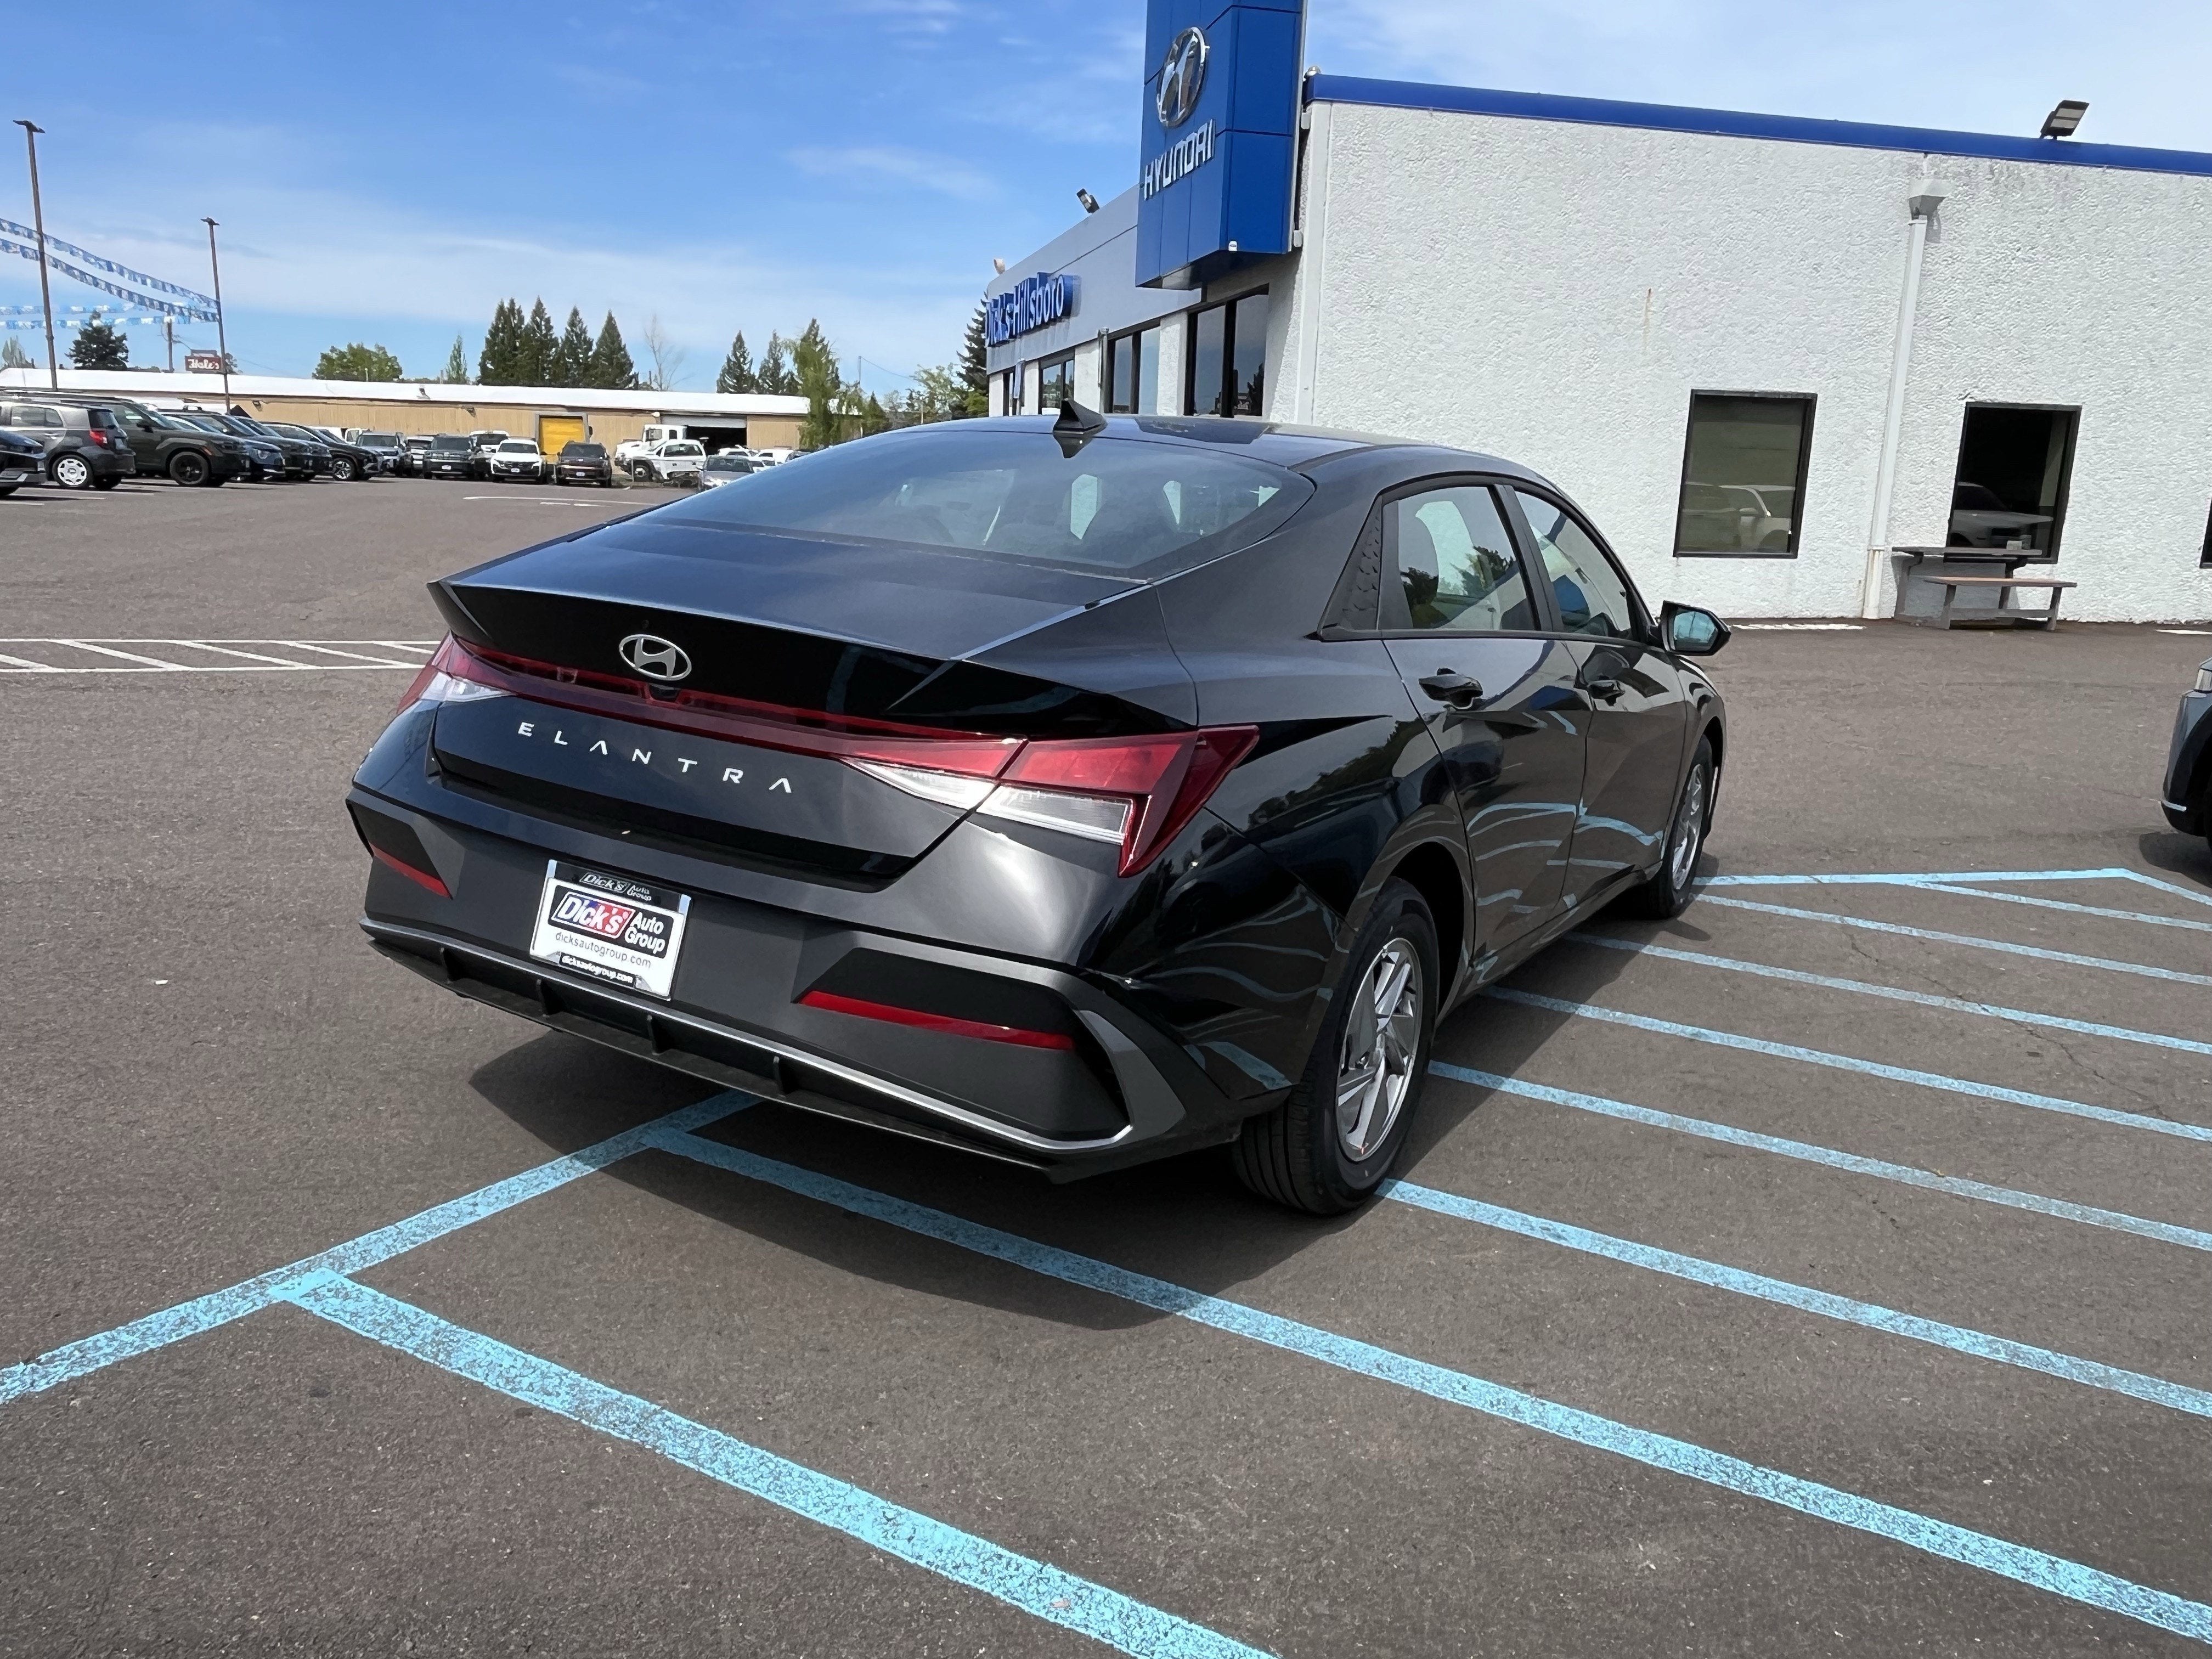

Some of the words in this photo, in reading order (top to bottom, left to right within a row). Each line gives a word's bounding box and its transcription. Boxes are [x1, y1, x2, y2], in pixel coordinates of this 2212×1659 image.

[1144, 119, 1214, 200] HYUNDAI
[1013, 273, 1065, 336] Hillsboro
[518, 722, 792, 793] ELANTRA
[625, 927, 665, 954] Group
[630, 912, 664, 935] Auto
[555, 932, 651, 969] dicksautogroup.com
